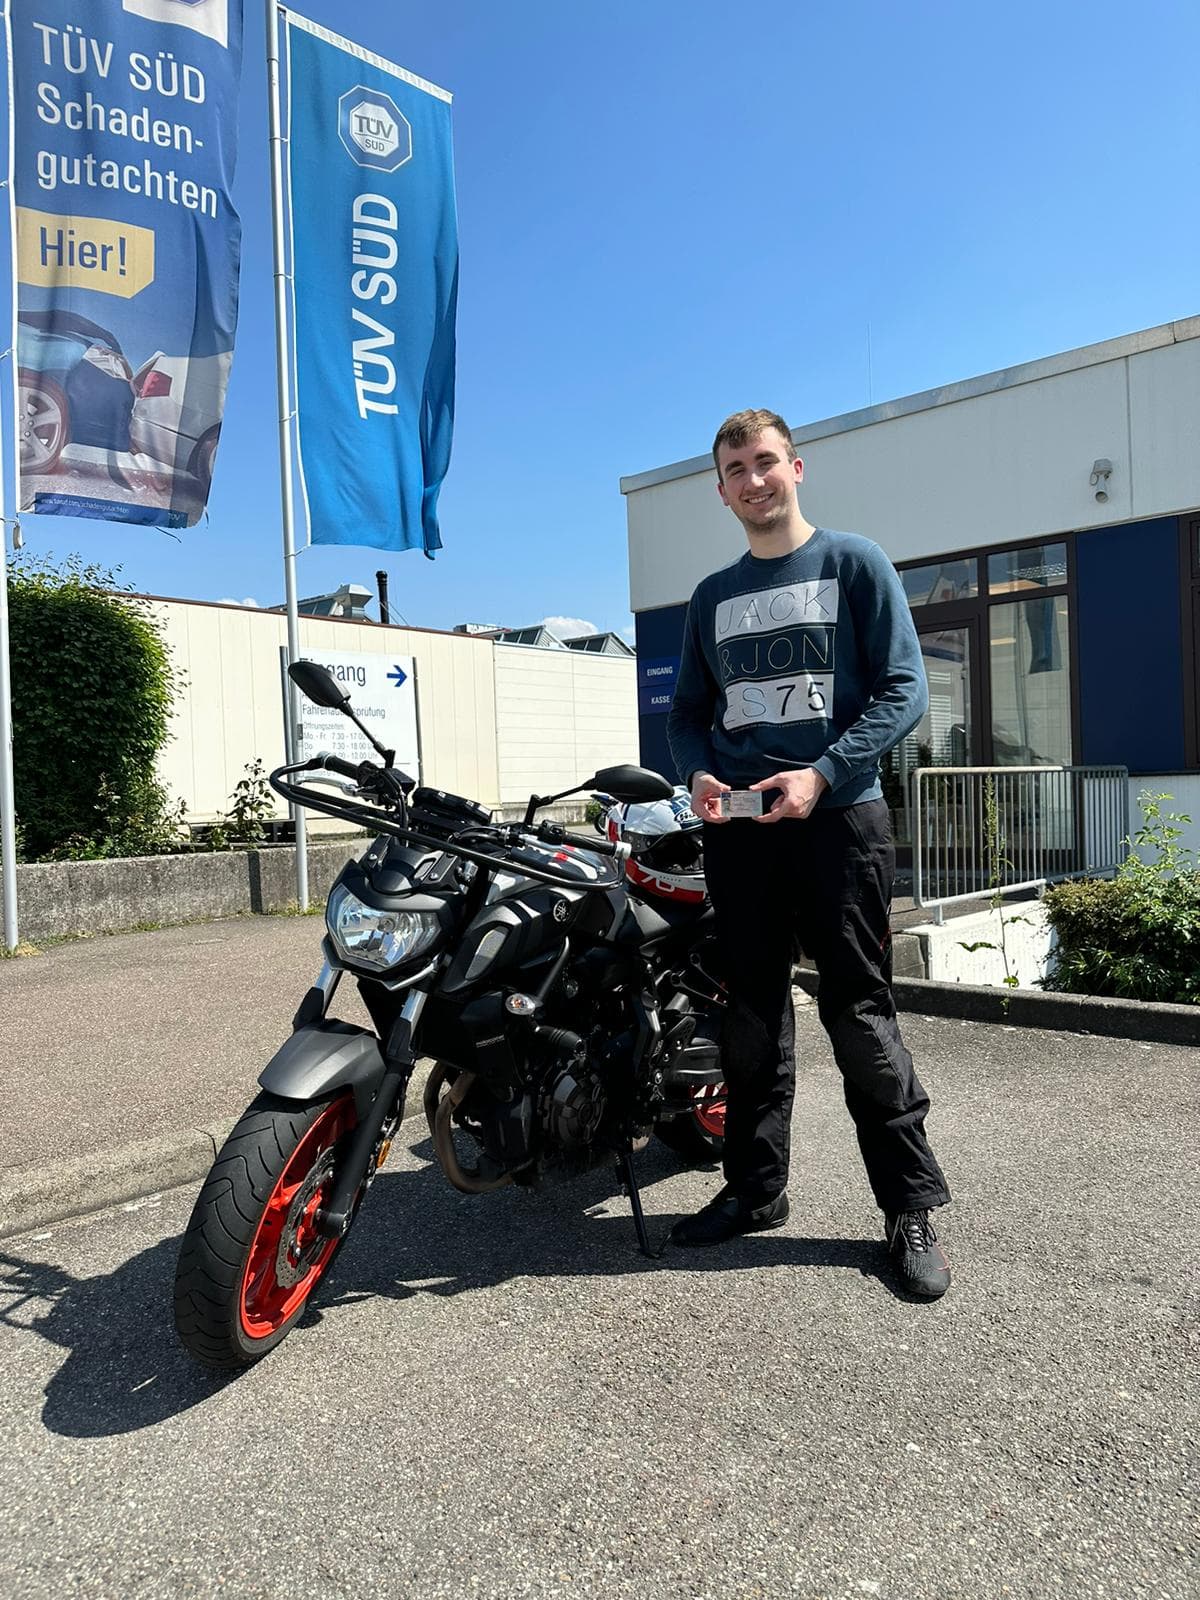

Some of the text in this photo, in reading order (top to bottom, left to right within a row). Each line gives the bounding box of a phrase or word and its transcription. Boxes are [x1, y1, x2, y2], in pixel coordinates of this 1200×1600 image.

[33, 22, 206, 104] TÜV SÜD
[37, 83, 204, 153] Schaden-
[354, 114, 394, 139] TÜV
[37, 150, 218, 219] gutachten
[39, 226, 128, 277] Hier!
[351, 192, 399, 420] TÜV SÜD
[719, 585, 830, 635] JACK
[646, 665, 673, 677] EINGANG
[651, 695, 671, 705] KASSE
